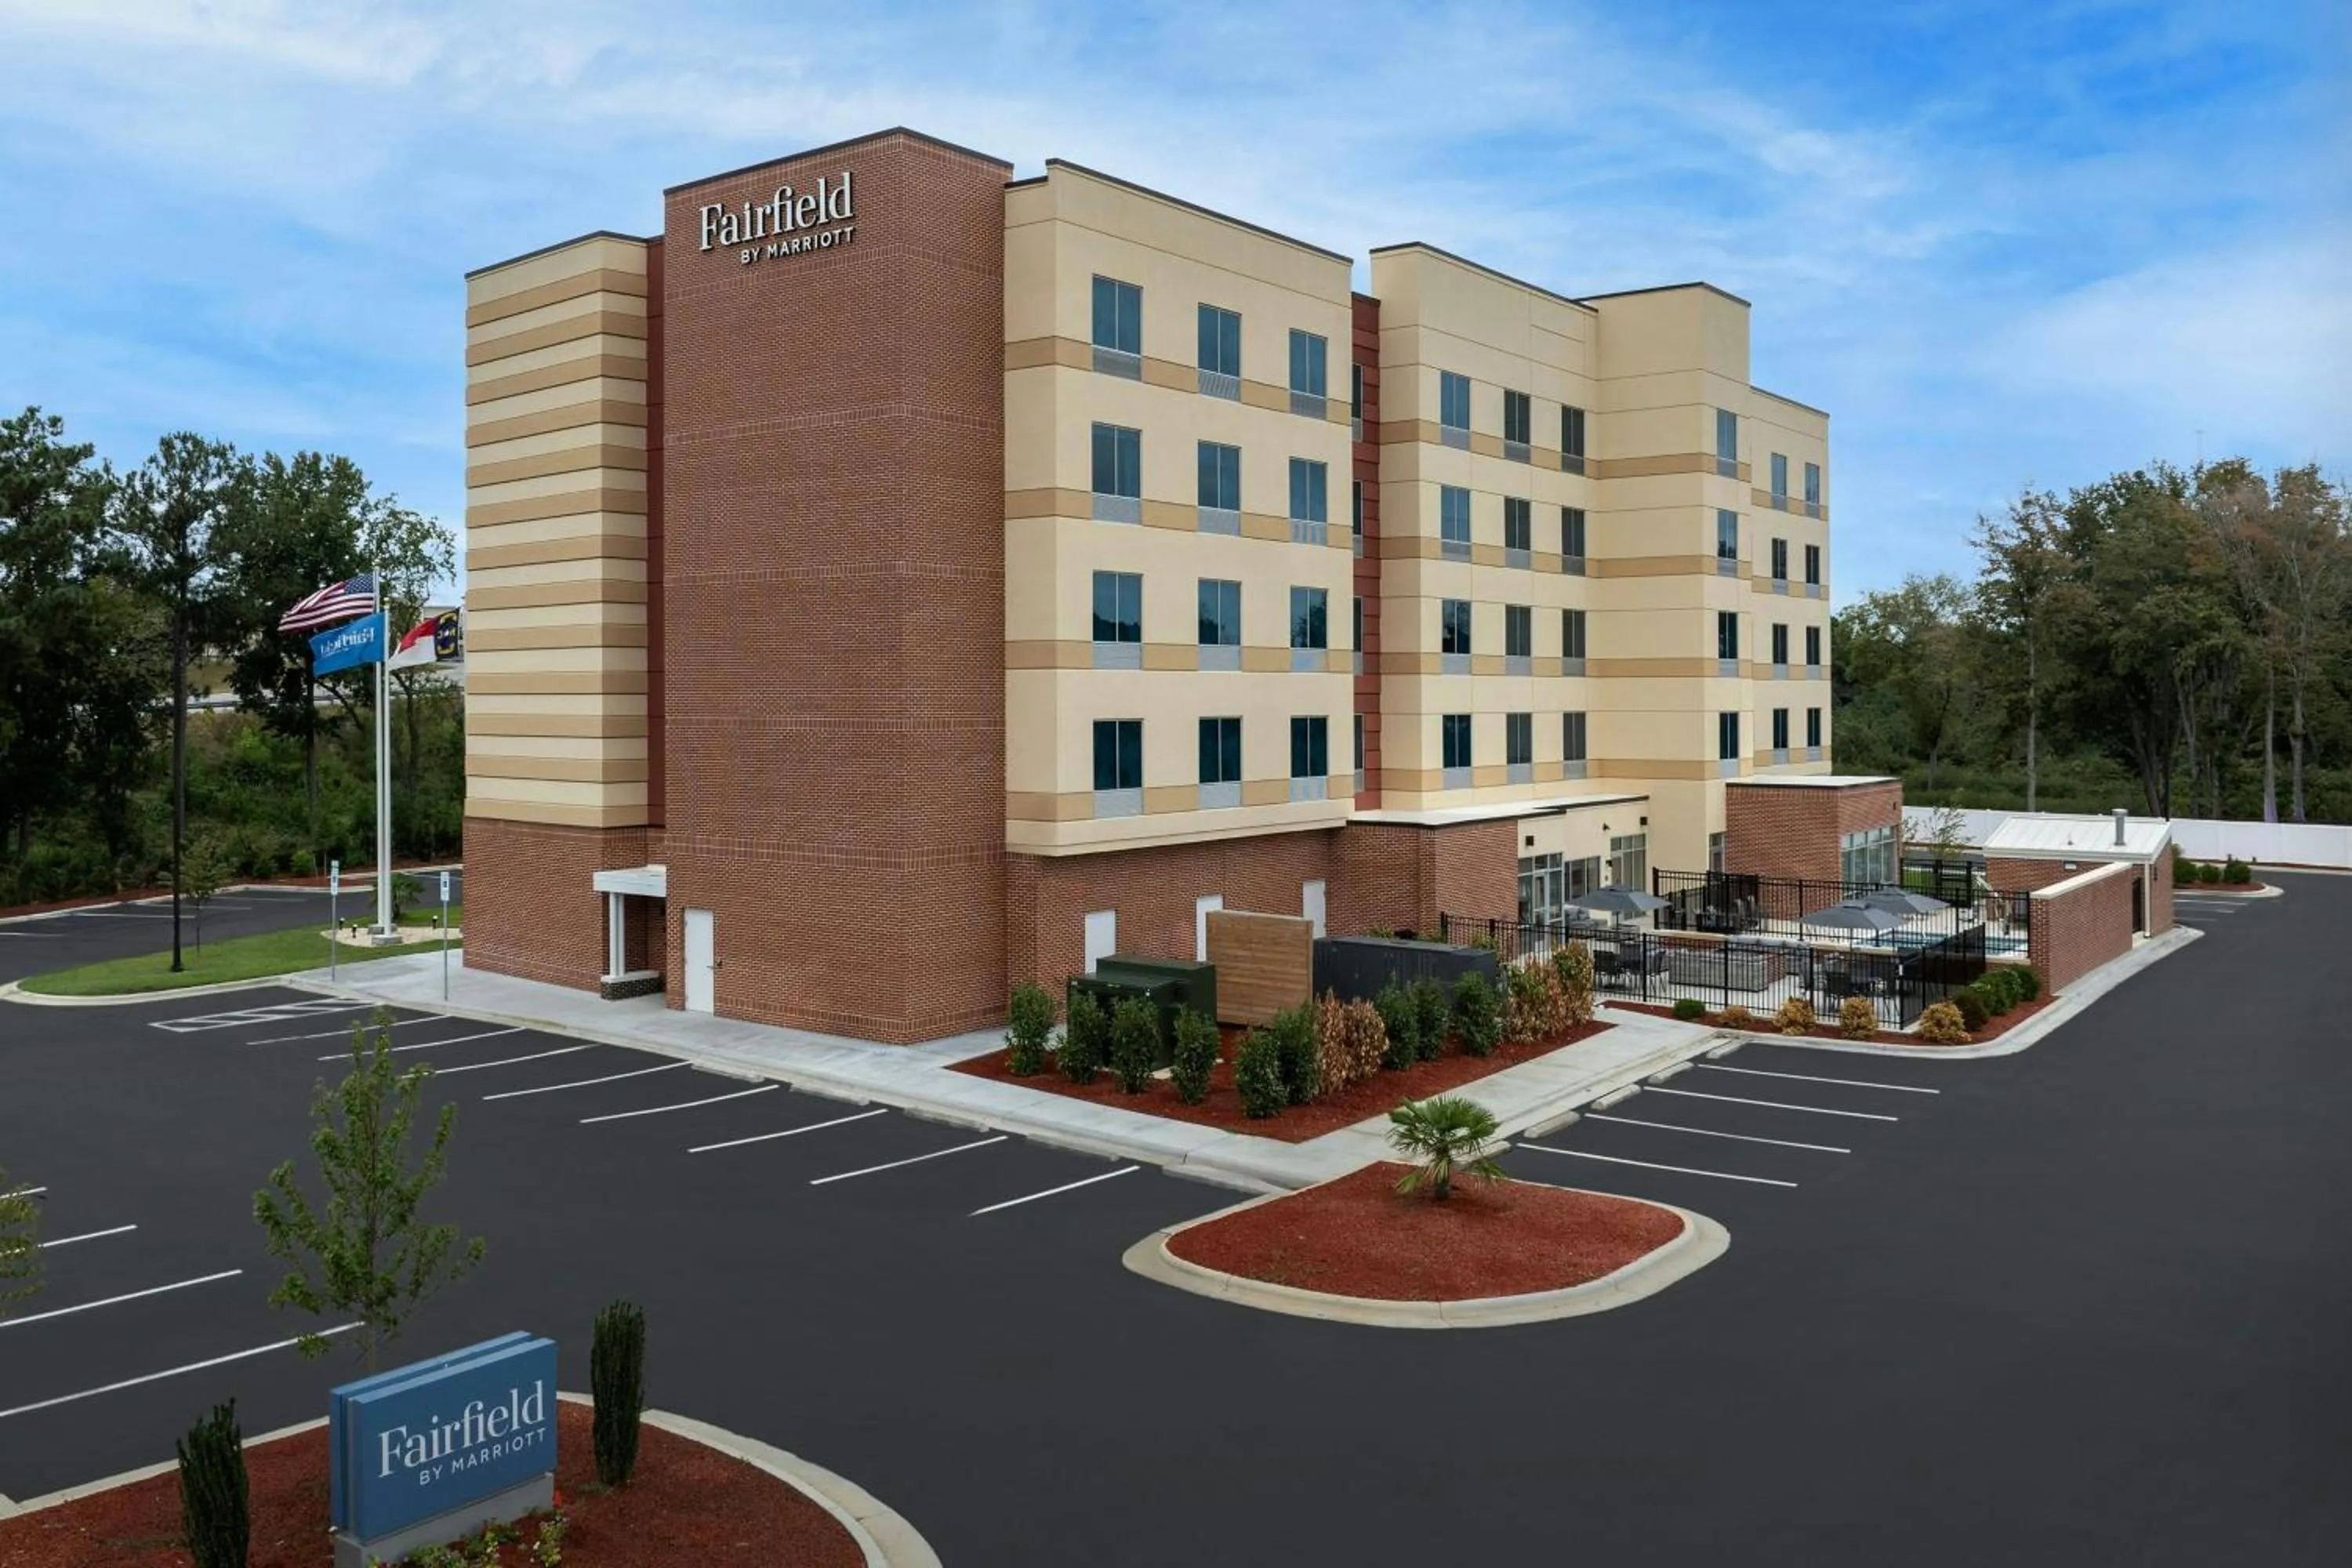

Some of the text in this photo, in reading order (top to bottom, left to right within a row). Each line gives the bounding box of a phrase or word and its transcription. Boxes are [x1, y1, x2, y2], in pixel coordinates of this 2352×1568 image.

[699, 171, 854, 251] Fairfield
[741, 227, 855, 264] BY MARRIOTT
[378, 1380, 546, 1478] Fairfield
[419, 1428, 546, 1485] BY MARRIOTT
